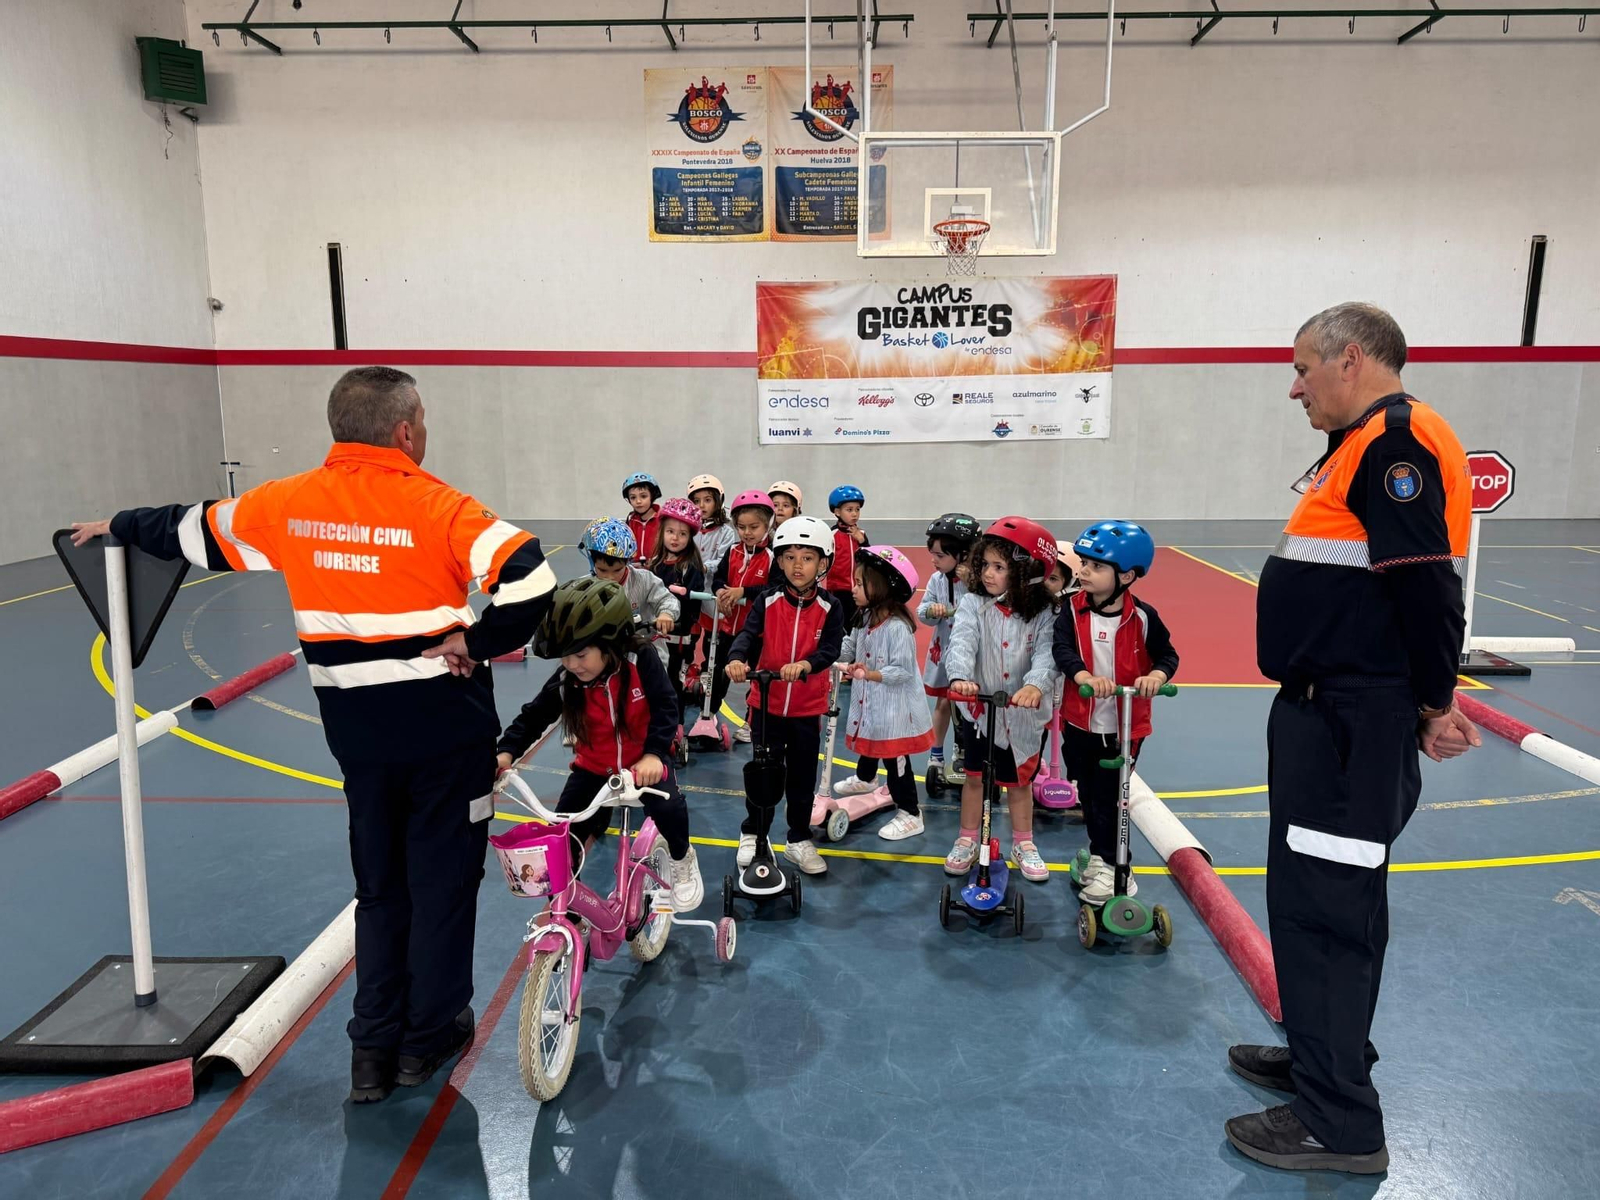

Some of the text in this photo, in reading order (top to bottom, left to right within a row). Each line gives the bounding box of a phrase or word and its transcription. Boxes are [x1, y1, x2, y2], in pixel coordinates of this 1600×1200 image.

[673, 149, 710, 157] Campeonato
[719, 148, 740, 157] España
[787, 147, 829, 156] Campeonato
[829, 147, 838, 155] de
[712, 171, 738, 180] Gallegas
[794, 171, 840, 179] Subcampeonas
[897, 283, 972, 305] CAMPUS
[857, 304, 1013, 340] GIGANTES
[882, 332, 986, 347] Basket Lover
[971, 345, 1012, 355] endesa
[768, 394, 829, 408] endesa
[858, 394, 895, 408] Kellogg's
[1012, 390, 1057, 398] azulmarino
[768, 427, 800, 437] luanvi
[1471, 475, 1507, 490] TOP
[287, 518, 415, 548] PROTECCIÓN CIVIL
[313, 550, 380, 574] OURENSE
